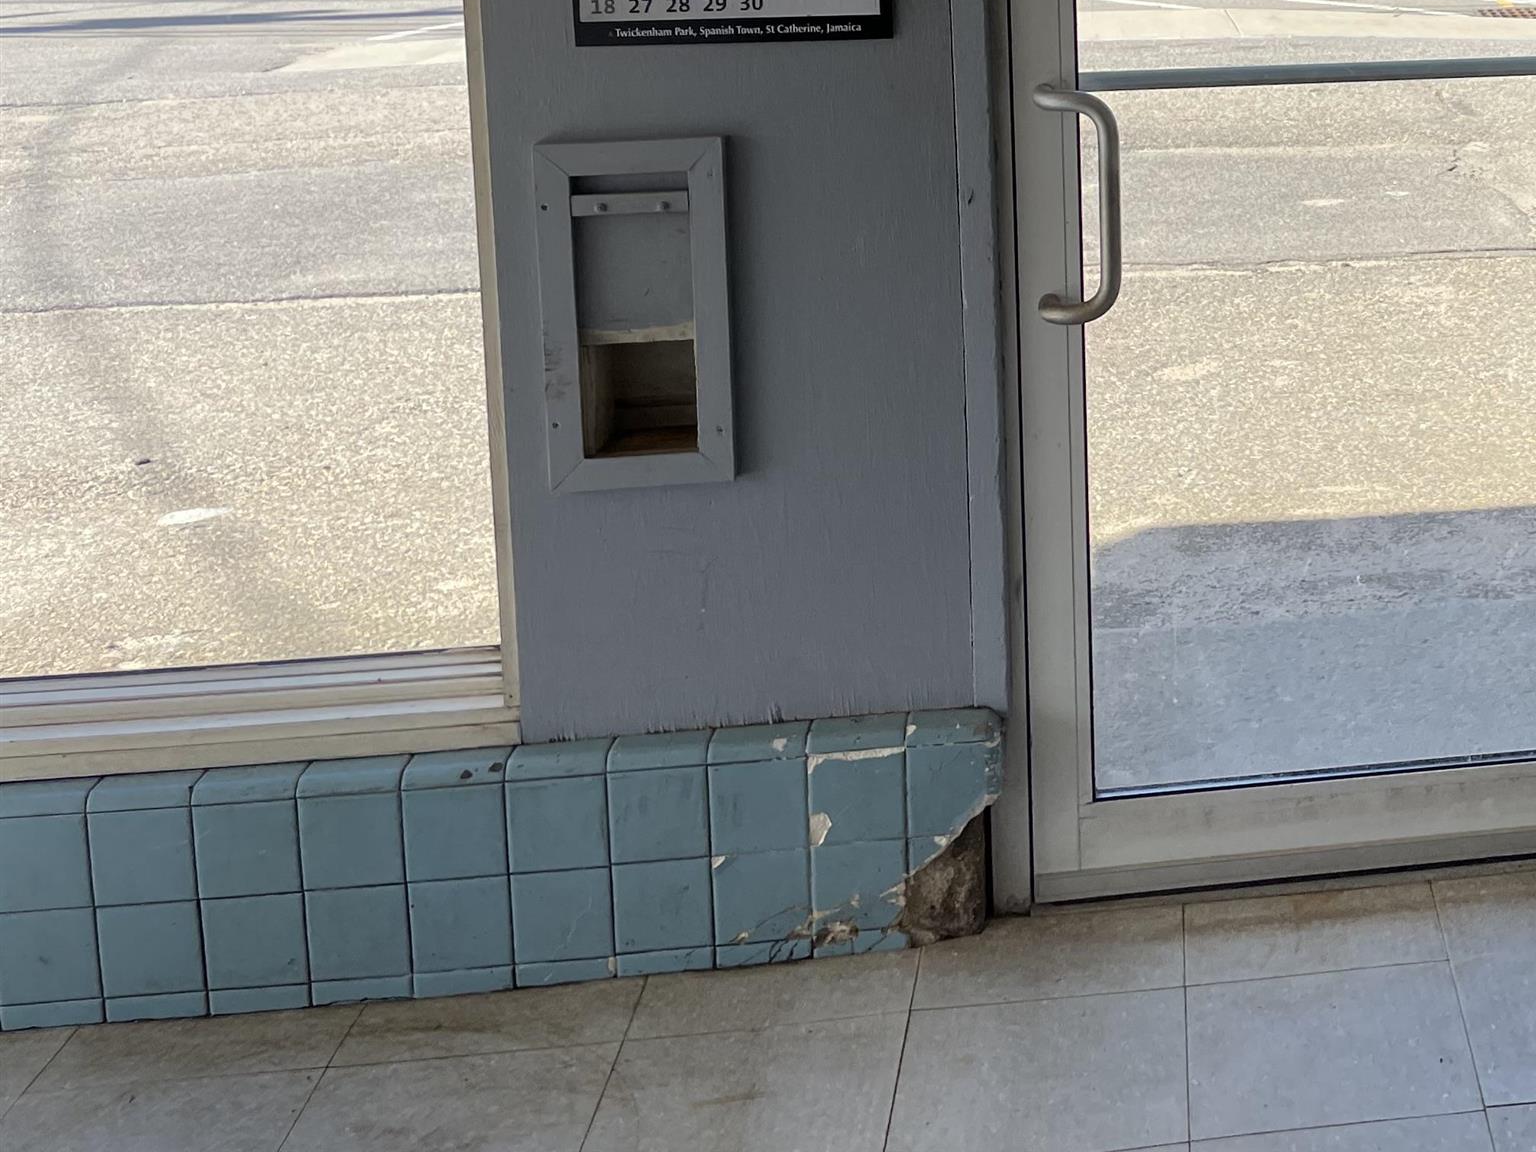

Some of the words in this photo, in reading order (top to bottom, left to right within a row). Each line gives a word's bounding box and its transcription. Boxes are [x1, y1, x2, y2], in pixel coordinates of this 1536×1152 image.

[615, 28, 672, 38] Twickenham
[674, 27, 697, 38] Park,
[700, 26, 734, 38] Spanish
[736, 26, 763, 36] Town,
[766, 25, 776, 35] St
[777, 24, 824, 35] Catherine,
[826, 22, 862, 34] Jamaica
